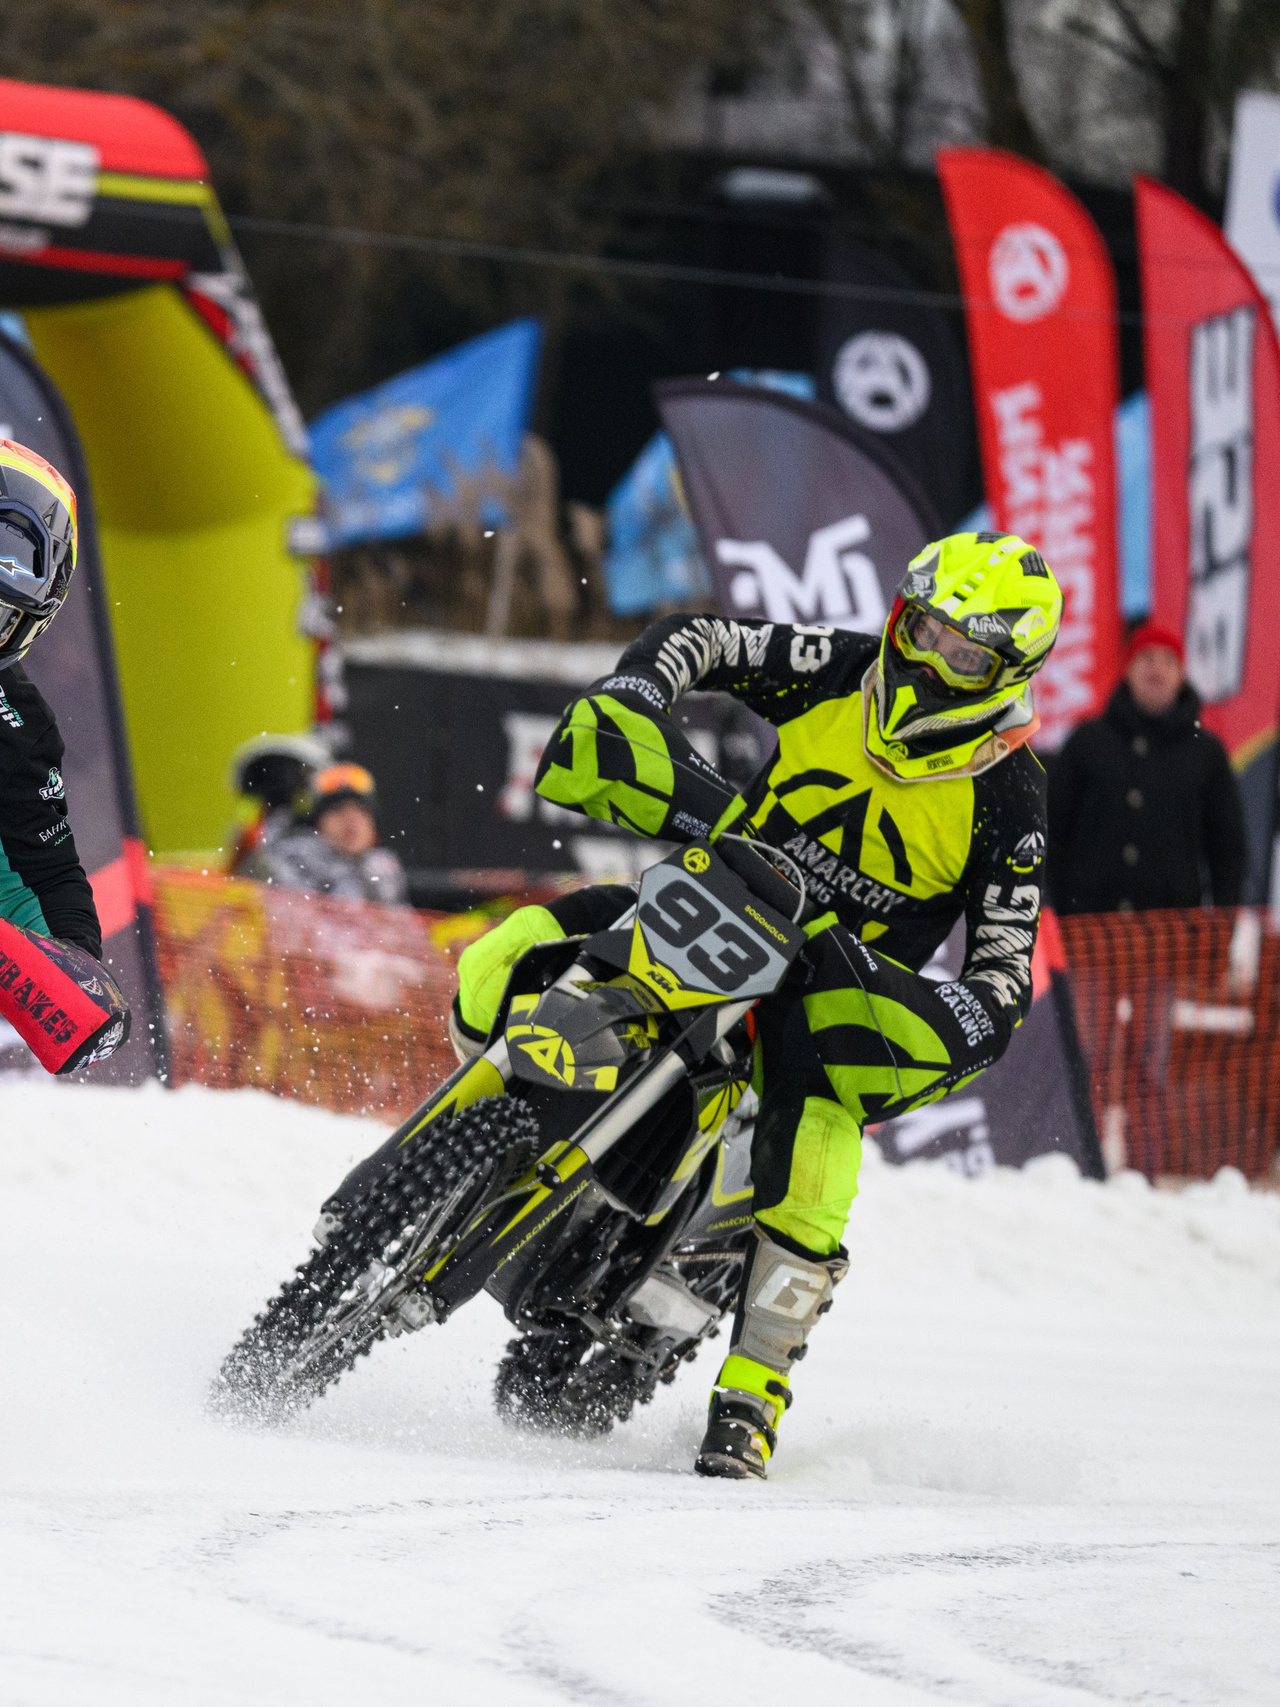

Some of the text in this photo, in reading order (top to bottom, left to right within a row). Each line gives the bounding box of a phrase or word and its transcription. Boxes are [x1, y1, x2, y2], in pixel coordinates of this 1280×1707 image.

[783, 832, 907, 914] ANARCHY
[638, 879, 770, 992] 93
[743, 904, 789, 945] BOGOMOLOV
[646, 970, 675, 995] KTM
[947, 981, 995, 1037] ANARCHY
[934, 984, 983, 1048] RACING
